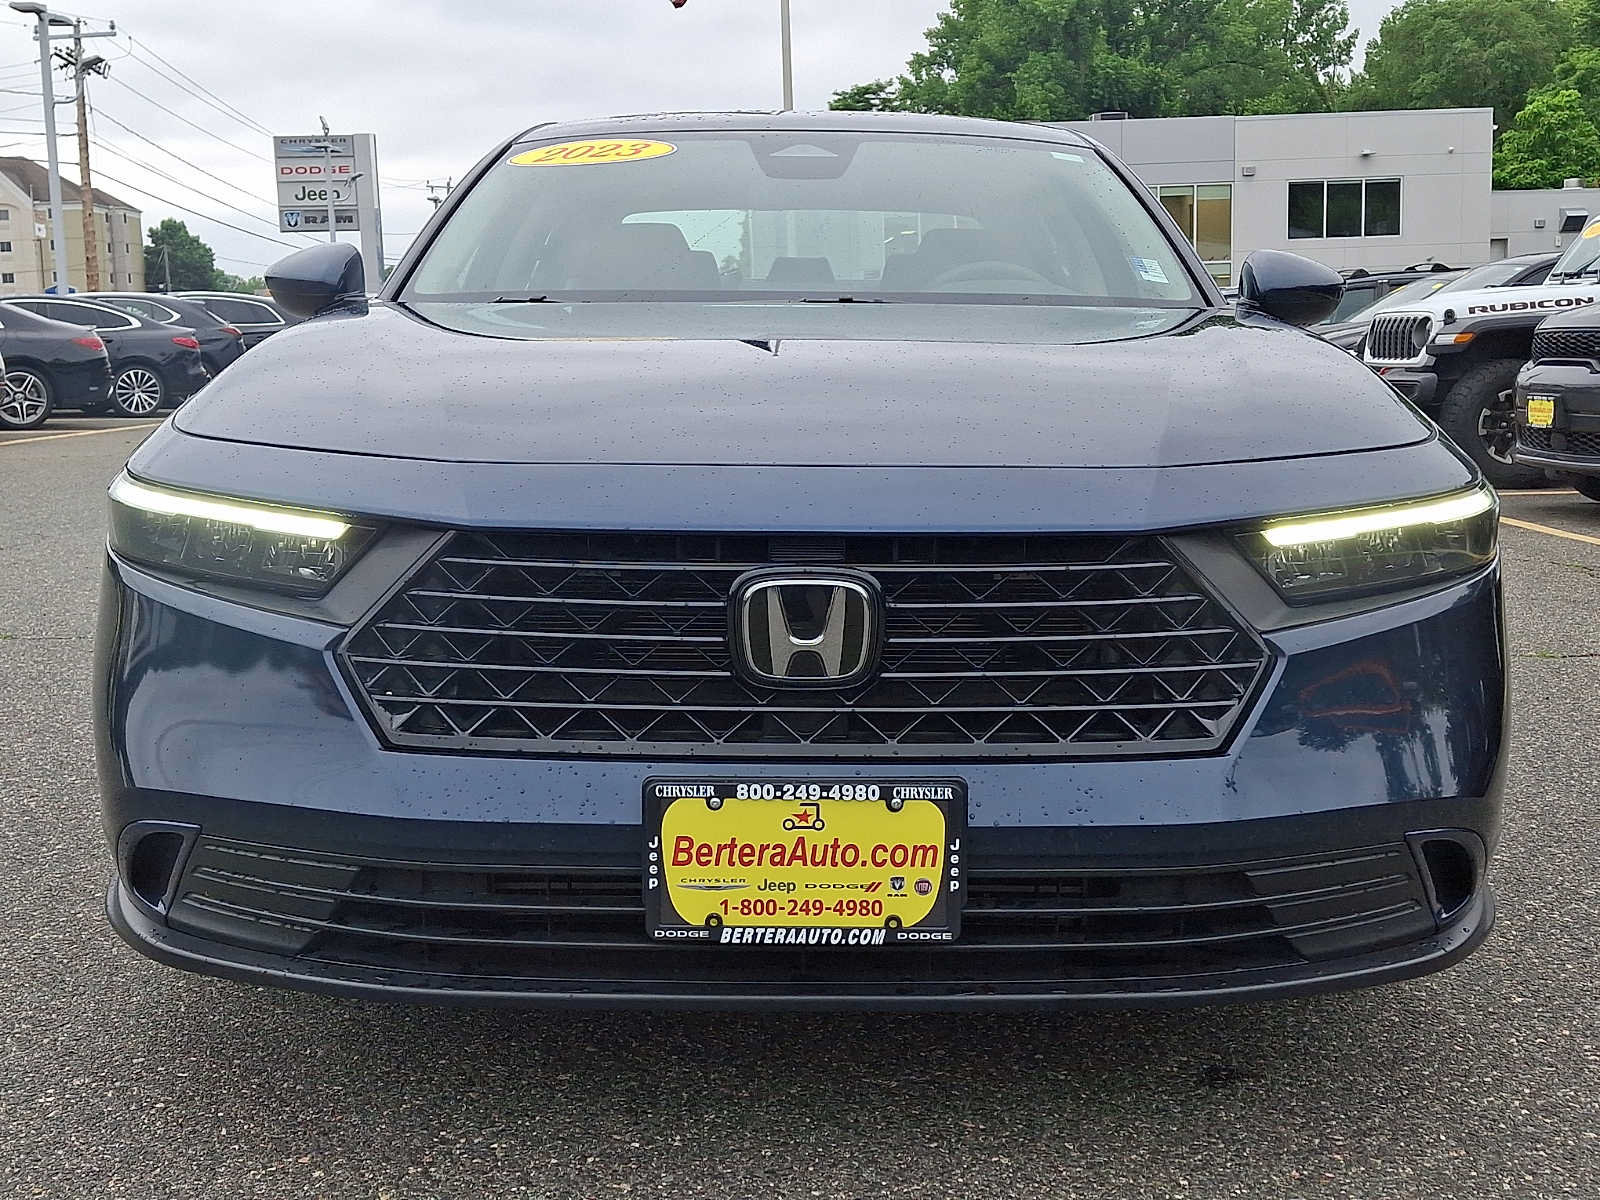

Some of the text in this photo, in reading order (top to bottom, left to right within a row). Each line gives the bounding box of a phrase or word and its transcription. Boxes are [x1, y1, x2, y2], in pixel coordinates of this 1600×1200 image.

[533, 143, 652, 163] 2023
[1468, 296, 1594, 315] RUBICON
[655, 785, 715, 798] CHRYSLER
[736, 783, 880, 801] 800-249-4980
[892, 786, 954, 800] CHRYSLER
[671, 835, 939, 869] BerteraAuto.com
[648, 836, 659, 890] Jeep
[949, 838, 960, 892] Jeep
[757, 878, 797, 894] Jeep
[719, 898, 884, 917] 1-800-249-4980
[654, 930, 711, 939] DODGE
[719, 927, 887, 946] BERTERAAUTO.COM
[897, 932, 953, 941] DODGE
